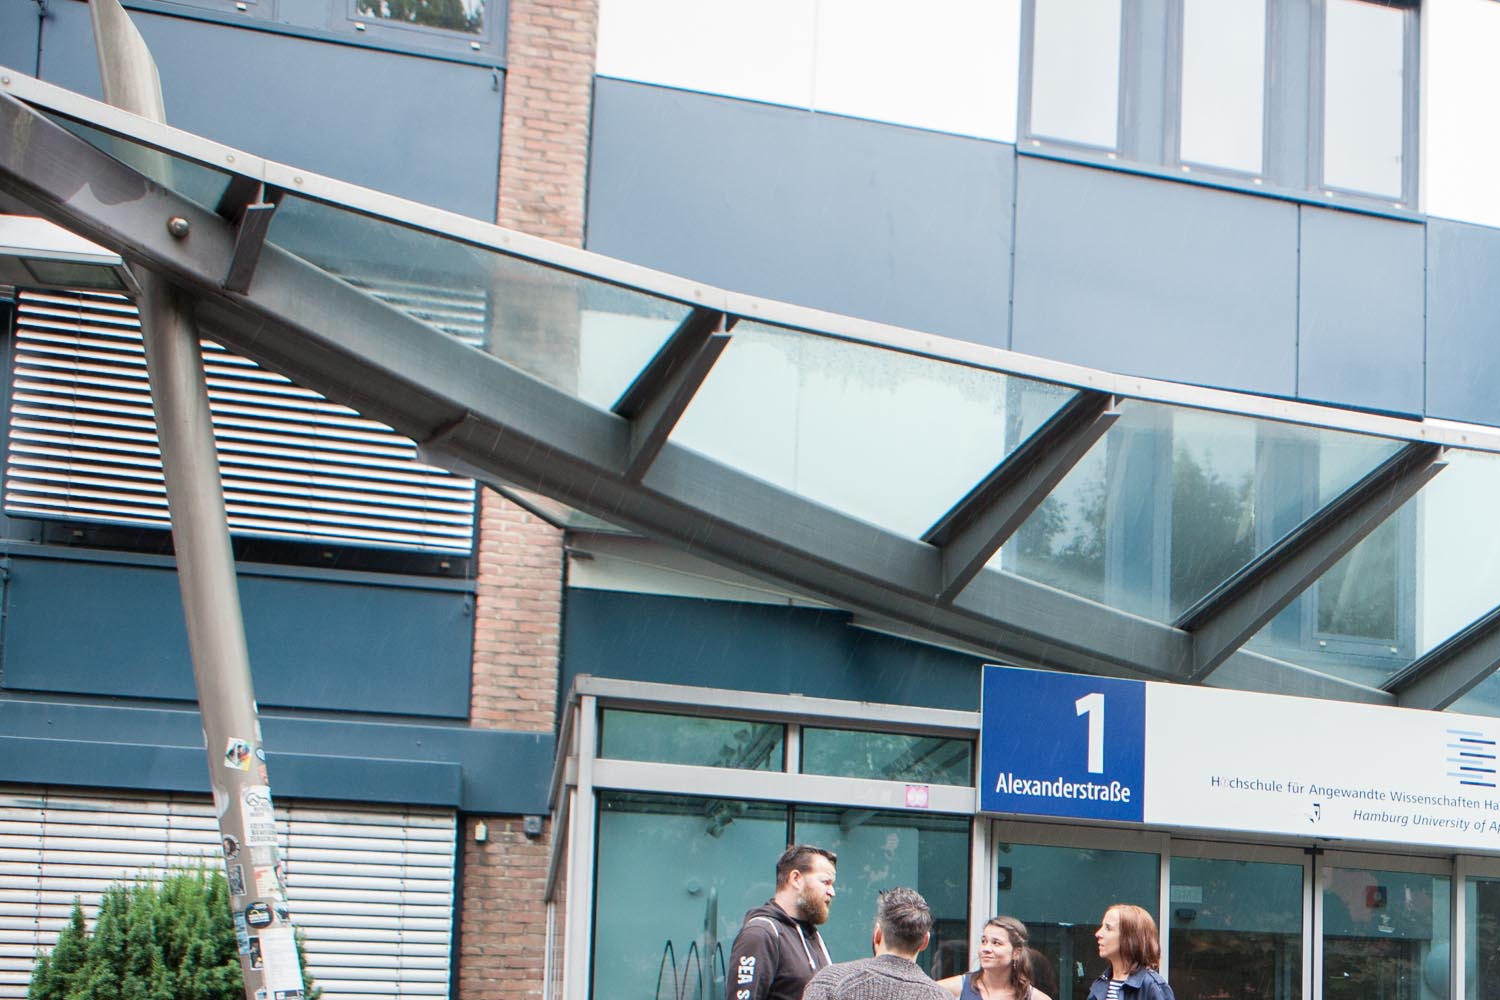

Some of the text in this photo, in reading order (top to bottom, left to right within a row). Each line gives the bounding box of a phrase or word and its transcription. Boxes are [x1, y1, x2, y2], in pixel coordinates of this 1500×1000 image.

[1074, 692, 1105, 774] 1
[995, 772, 1131, 803] Alexanderstraße
[1211, 775, 1283, 793] Hchschule
[1287, 780, 1304, 794] für
[1309, 785, 1385, 802] Angewandte
[1390, 791, 1480, 809] Wissenschaften
[1353, 808, 1409, 827] Hamburg
[1413, 814, 1470, 832] University
[1473, 818, 1487, 834] of
[737, 956, 756, 984] SEA
